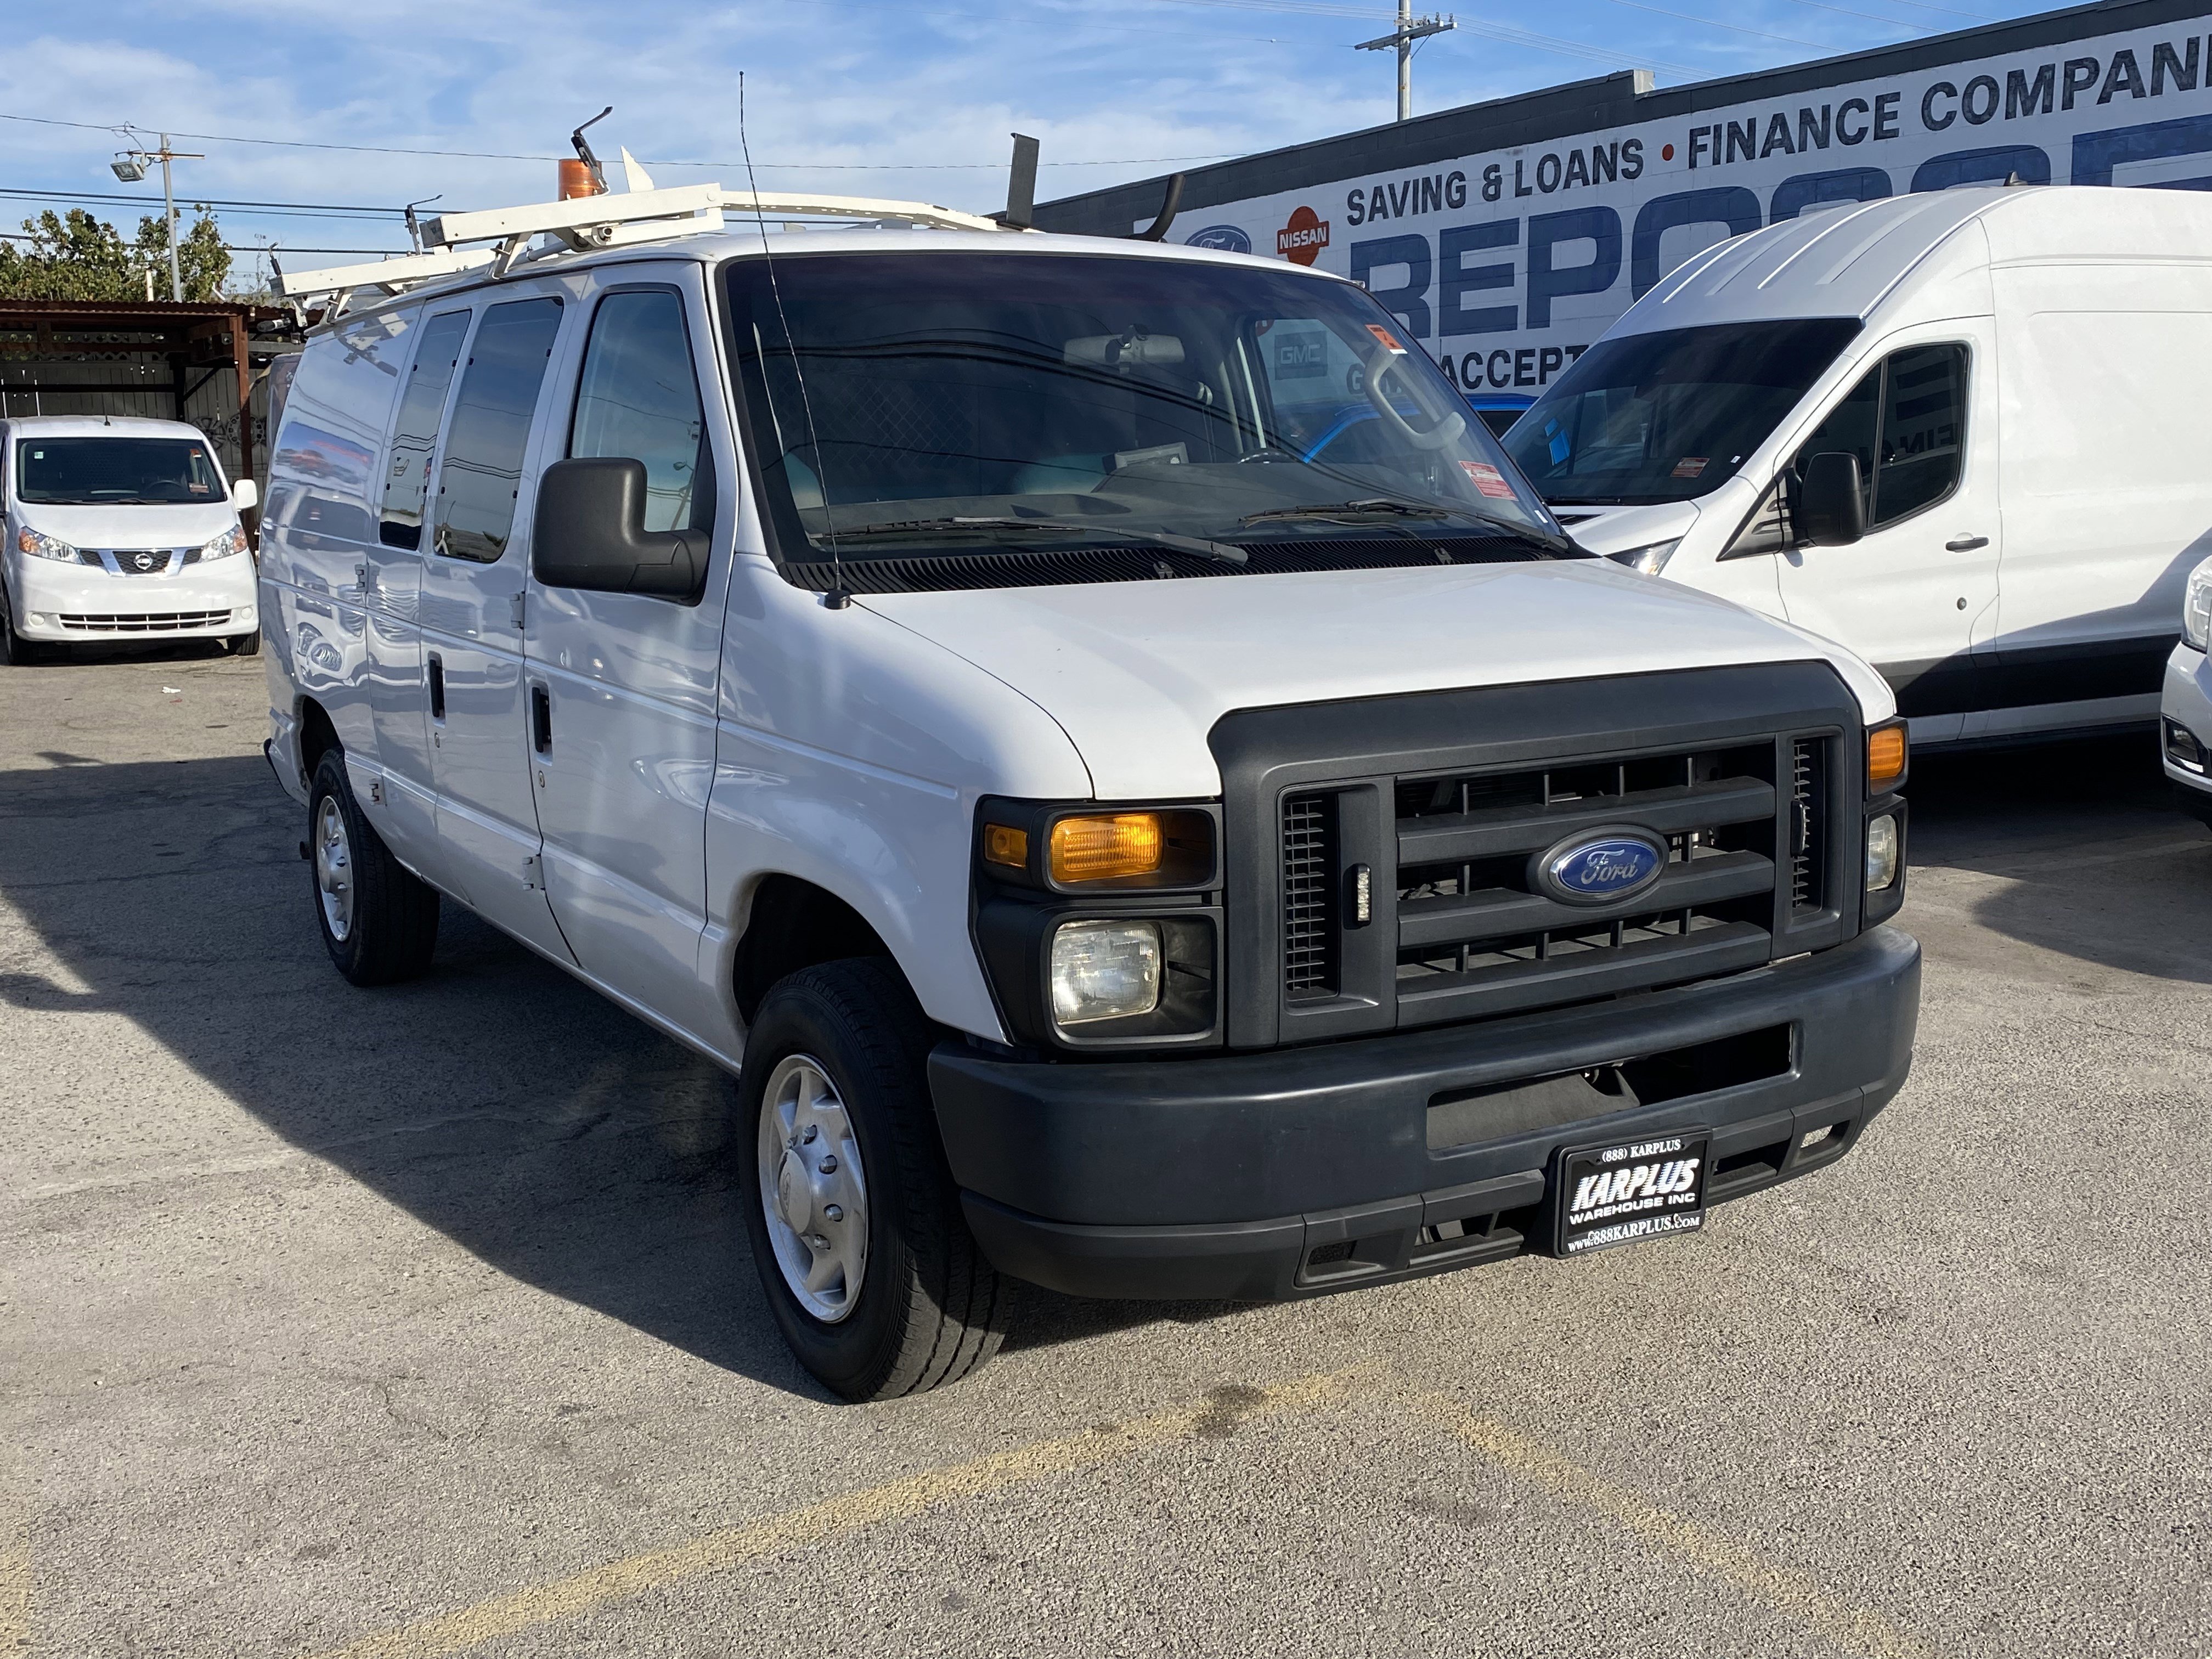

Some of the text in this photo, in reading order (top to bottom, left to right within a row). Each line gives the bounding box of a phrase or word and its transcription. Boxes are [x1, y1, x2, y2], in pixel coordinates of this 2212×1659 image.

[1347, 171, 1466, 226] SAVING
[1482, 164, 1503, 202] &
[1515, 138, 1644, 198] LOANS
[1689, 92, 1901, 170] FINANCE
[1279, 226, 1327, 250] NISSAN
[1280, 343, 1321, 364] GMC
[1581, 849, 1640, 884] Ford
[1601, 1138, 1681, 1163] (888) KARPLUS
[1570, 1158, 1700, 1211] KARPLUS
[1569, 1192, 1695, 1225] WAREHOUSE INC
